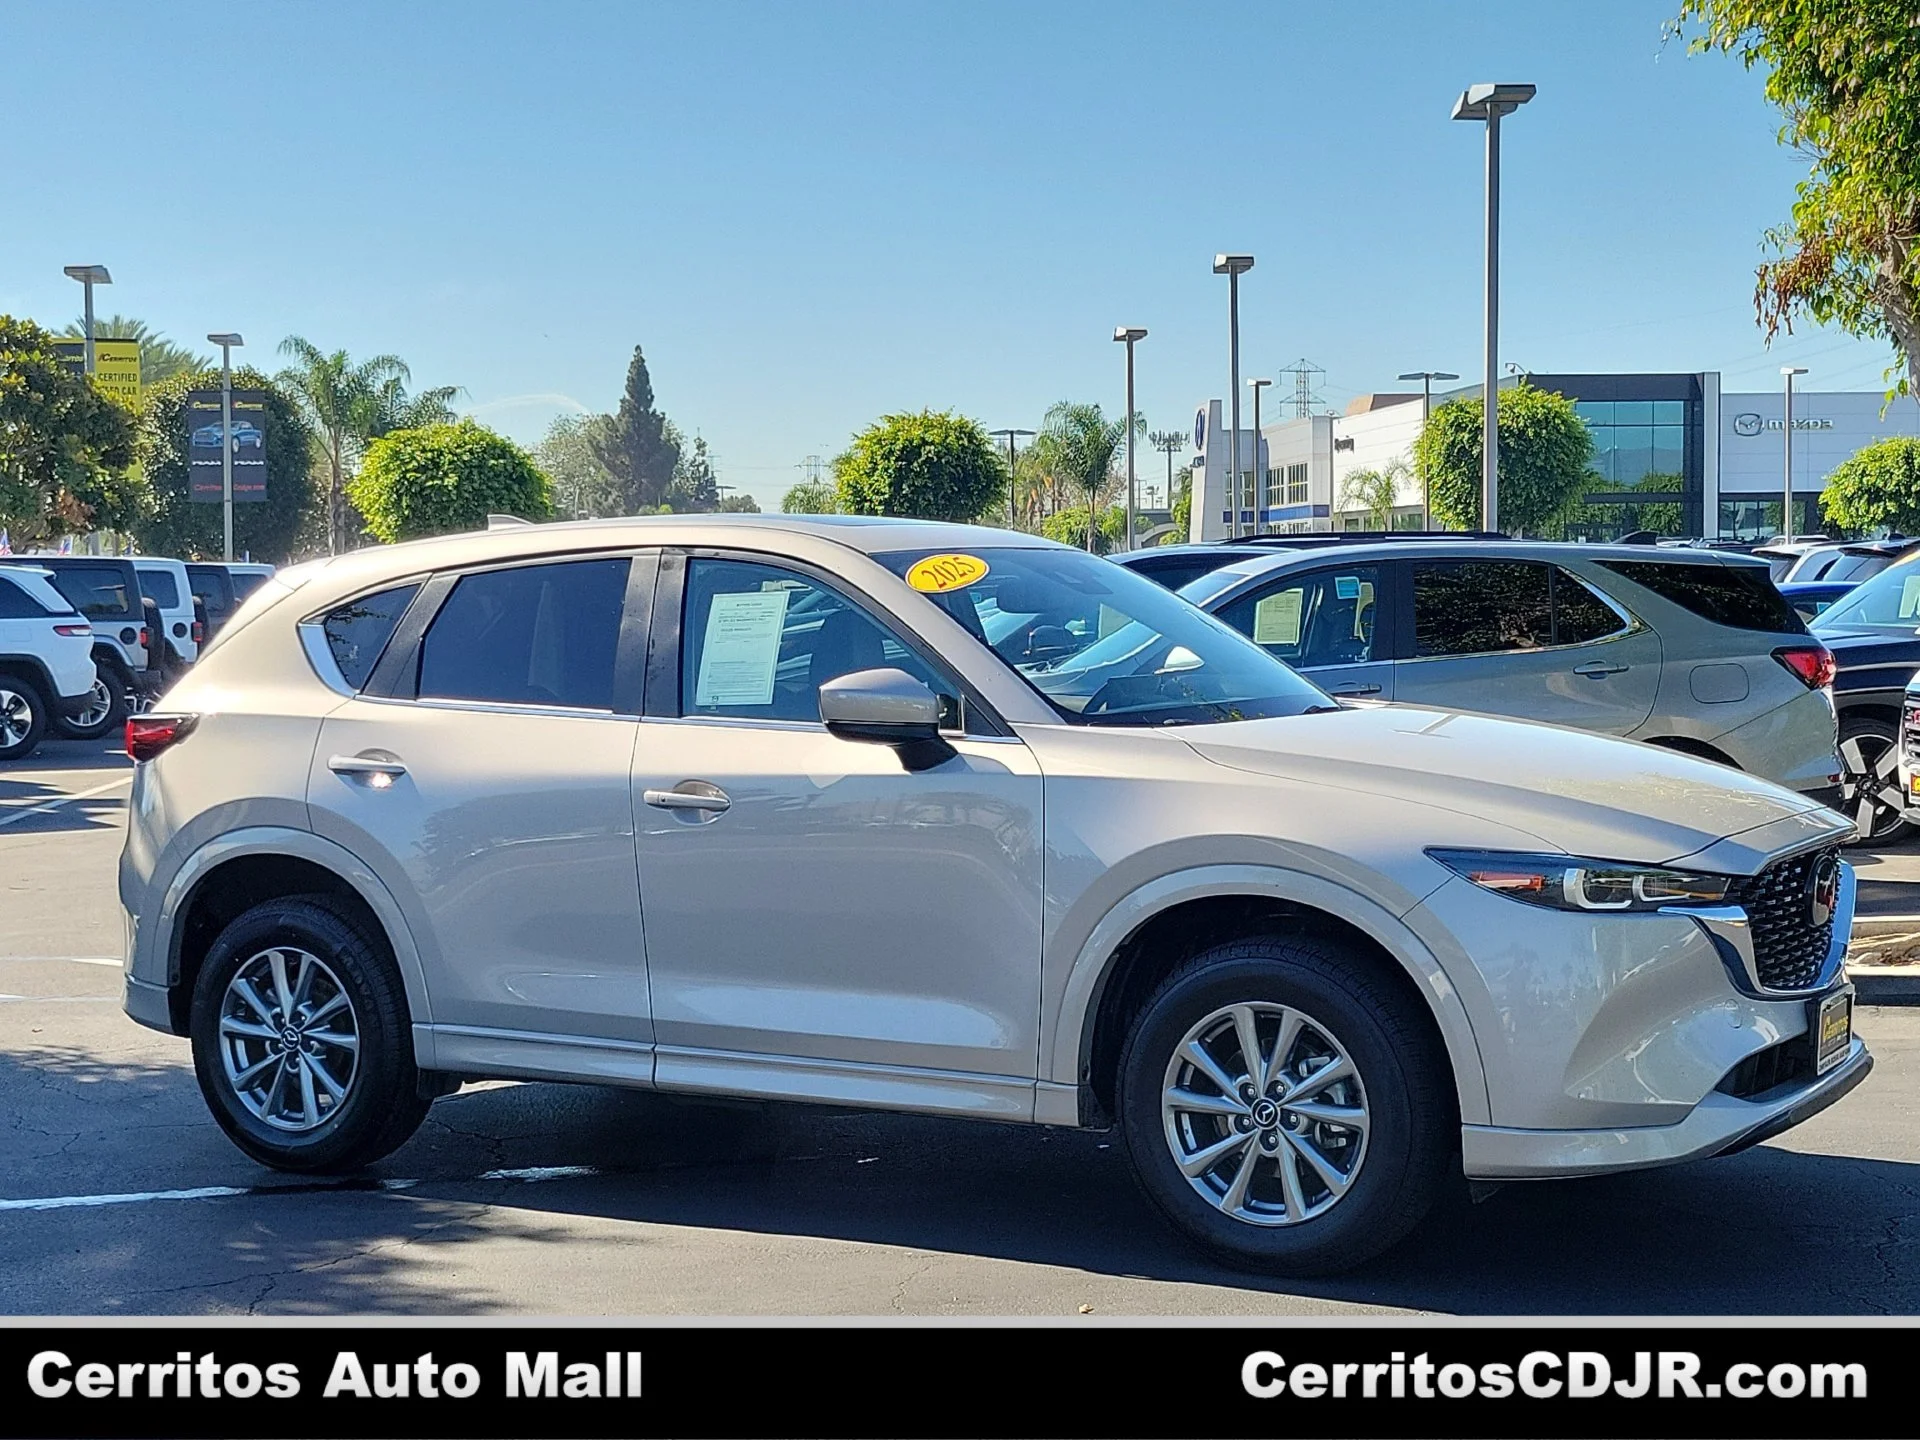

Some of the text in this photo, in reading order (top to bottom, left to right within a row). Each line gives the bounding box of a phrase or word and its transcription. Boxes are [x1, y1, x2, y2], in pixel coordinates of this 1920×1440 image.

[98, 373, 138, 382] CERTIFIED
[122, 386, 137, 395] CAR
[921, 557, 976, 588] 2025
